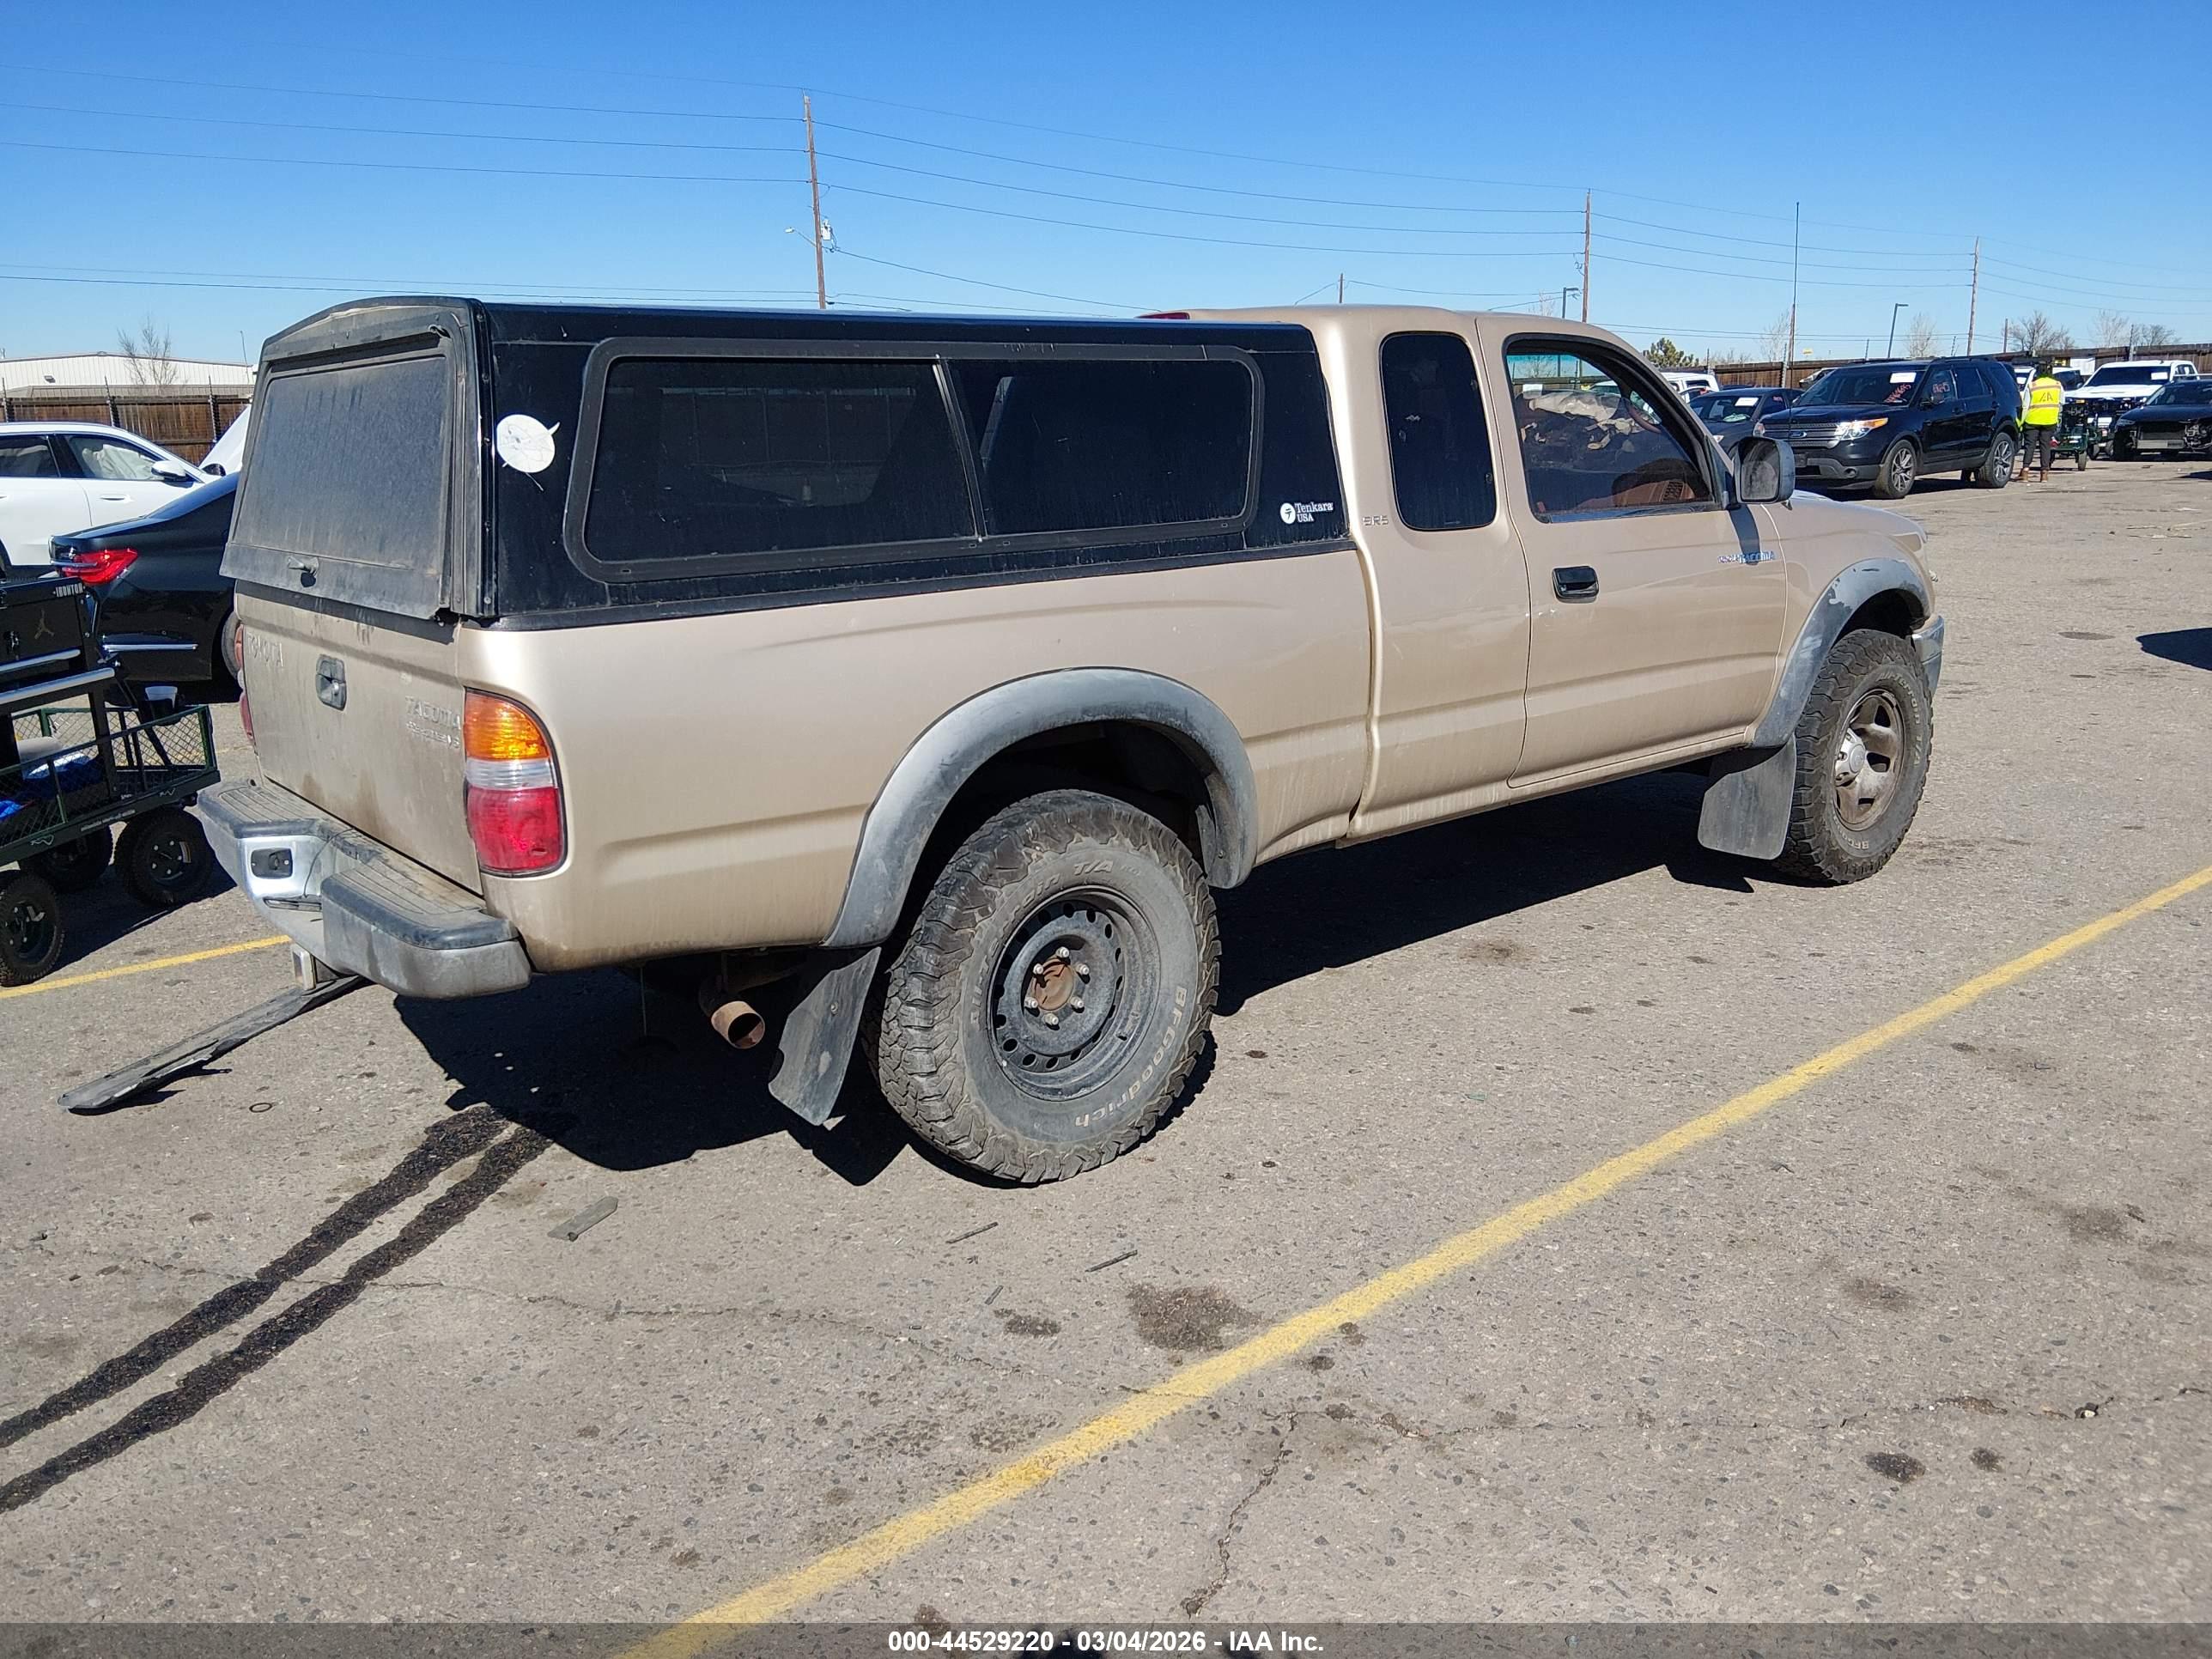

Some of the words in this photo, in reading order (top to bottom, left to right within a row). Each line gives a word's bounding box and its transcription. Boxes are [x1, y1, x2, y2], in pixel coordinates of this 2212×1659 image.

[1294, 501, 1334, 514] Tenkara
[1296, 513, 1315, 523] USA
[1362, 515, 1389, 526] SR5
[246, 630, 283, 667] TOYOTA
[1074, 859, 1114, 877] T/A
[1074, 985, 1188, 1127] BFGoodrich
